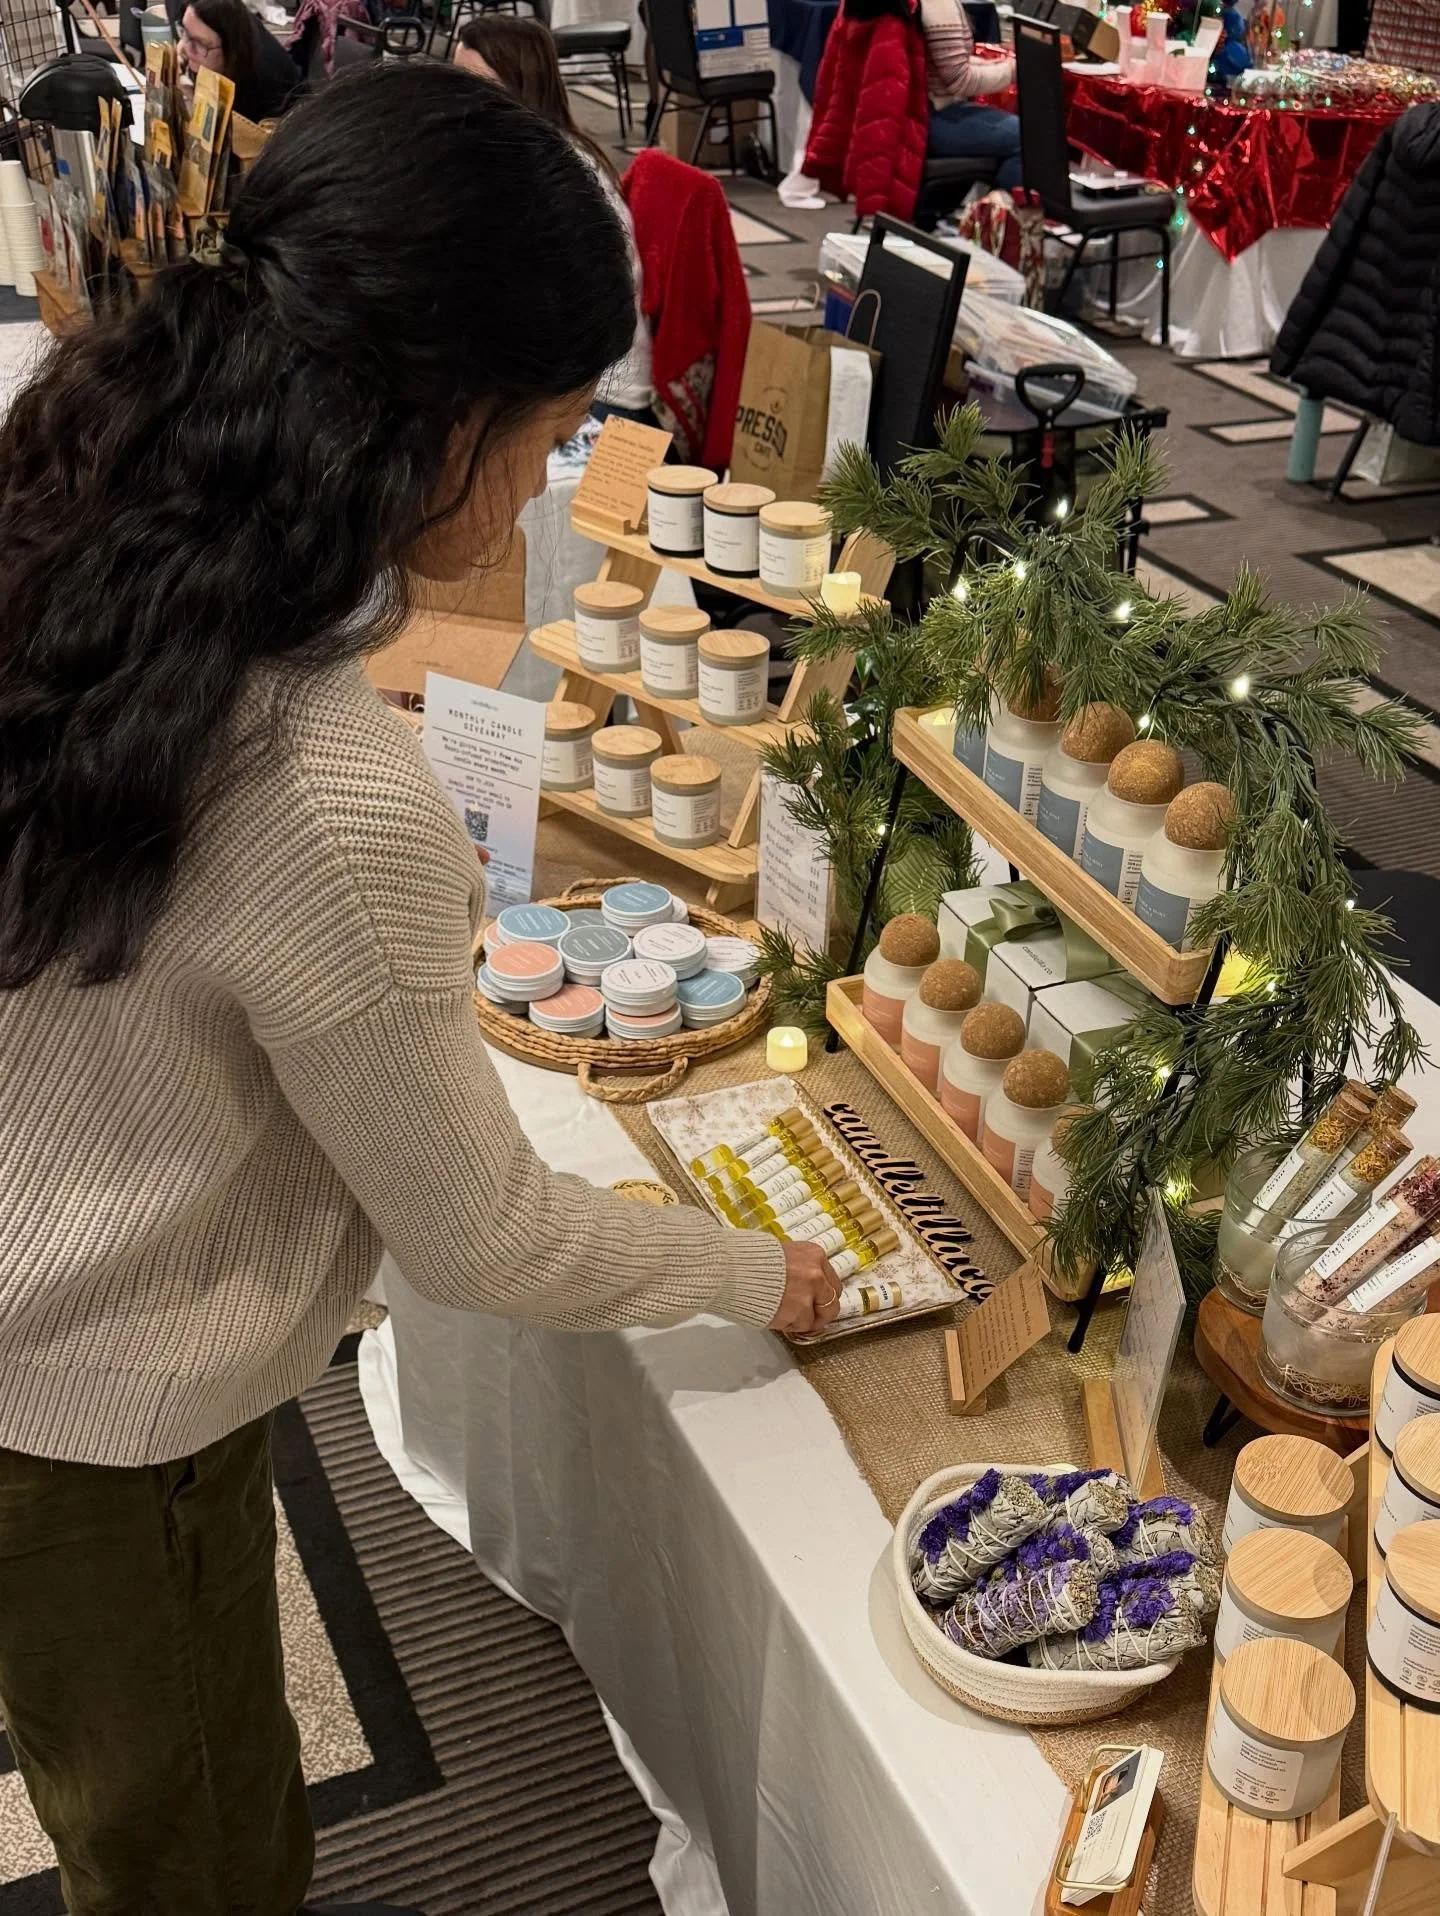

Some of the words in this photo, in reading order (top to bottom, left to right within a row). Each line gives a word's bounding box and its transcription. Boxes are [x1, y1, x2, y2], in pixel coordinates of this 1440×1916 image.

[448, 708, 485, 725] MONTHLY
[491, 720, 522, 737] CANDLE
[463, 722, 505, 740] GIVEAWAY
